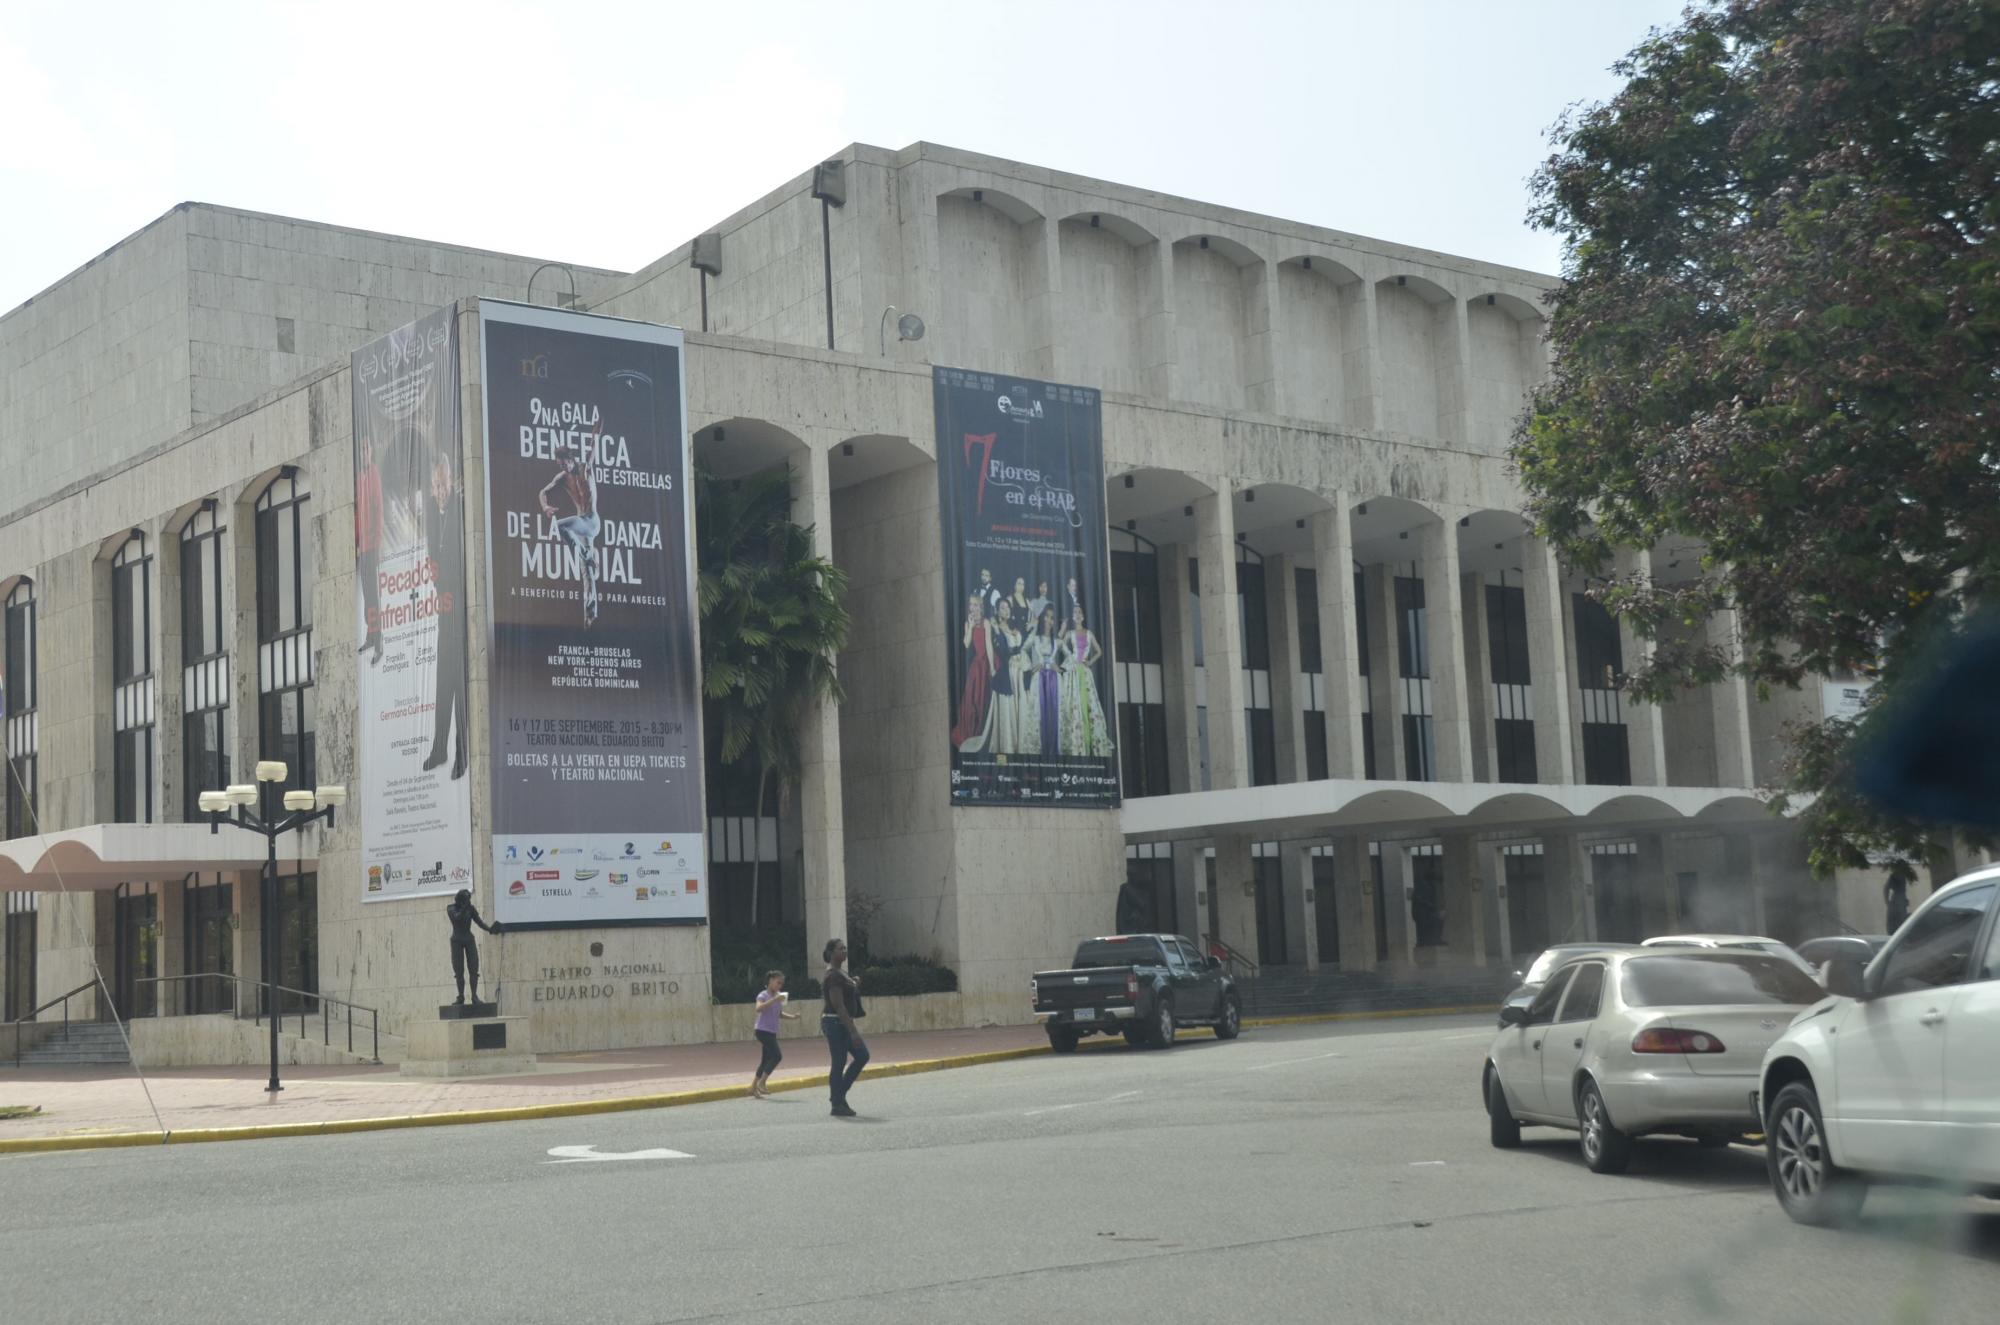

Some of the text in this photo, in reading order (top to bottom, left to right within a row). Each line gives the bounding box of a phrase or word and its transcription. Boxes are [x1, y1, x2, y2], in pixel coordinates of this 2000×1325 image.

[561, 401, 600, 426] GALA
[520, 424, 631, 468] BENÉFICA
[595, 467, 672, 490] DE ESTRELLAS
[964, 432, 1040, 516] 7 Flores
[1005, 486, 1076, 511] en el BAR
[507, 511, 662, 550] DE LA DANZA
[379, 557, 440, 598] Pecados
[511, 587, 666, 606] A BENEFICIO DE NO PARA ANGELES
[558, 645, 631, 658] FRANCIA-BRUSELAS
[548, 656, 642, 668] NEW YORK-BUENOS AIRES
[573, 667, 618, 678] CHILE-CUBA
[552, 676, 640, 689] REPÚBLICA DOMINICANA
[509, 718, 520, 732] 16
[522, 719, 528, 731] Y
[531, 719, 541, 732] 17
[544, 719, 556, 732] DE
[620, 722, 641, 734] 2015
[527, 734, 665, 749] TEATRO NACIONAL EDUARDO BRITO
[507, 753, 686, 769] BOLETAS A LA VENTA EN UEPA TICKETS
[551, 769, 645, 782] Y TEATRO NACIONAL
[542, 888, 573, 897] ESTRELLA
[542, 962, 666, 979] TEATRO NACIONAL
[533, 981, 679, 1001] EDUARDO BRITO
